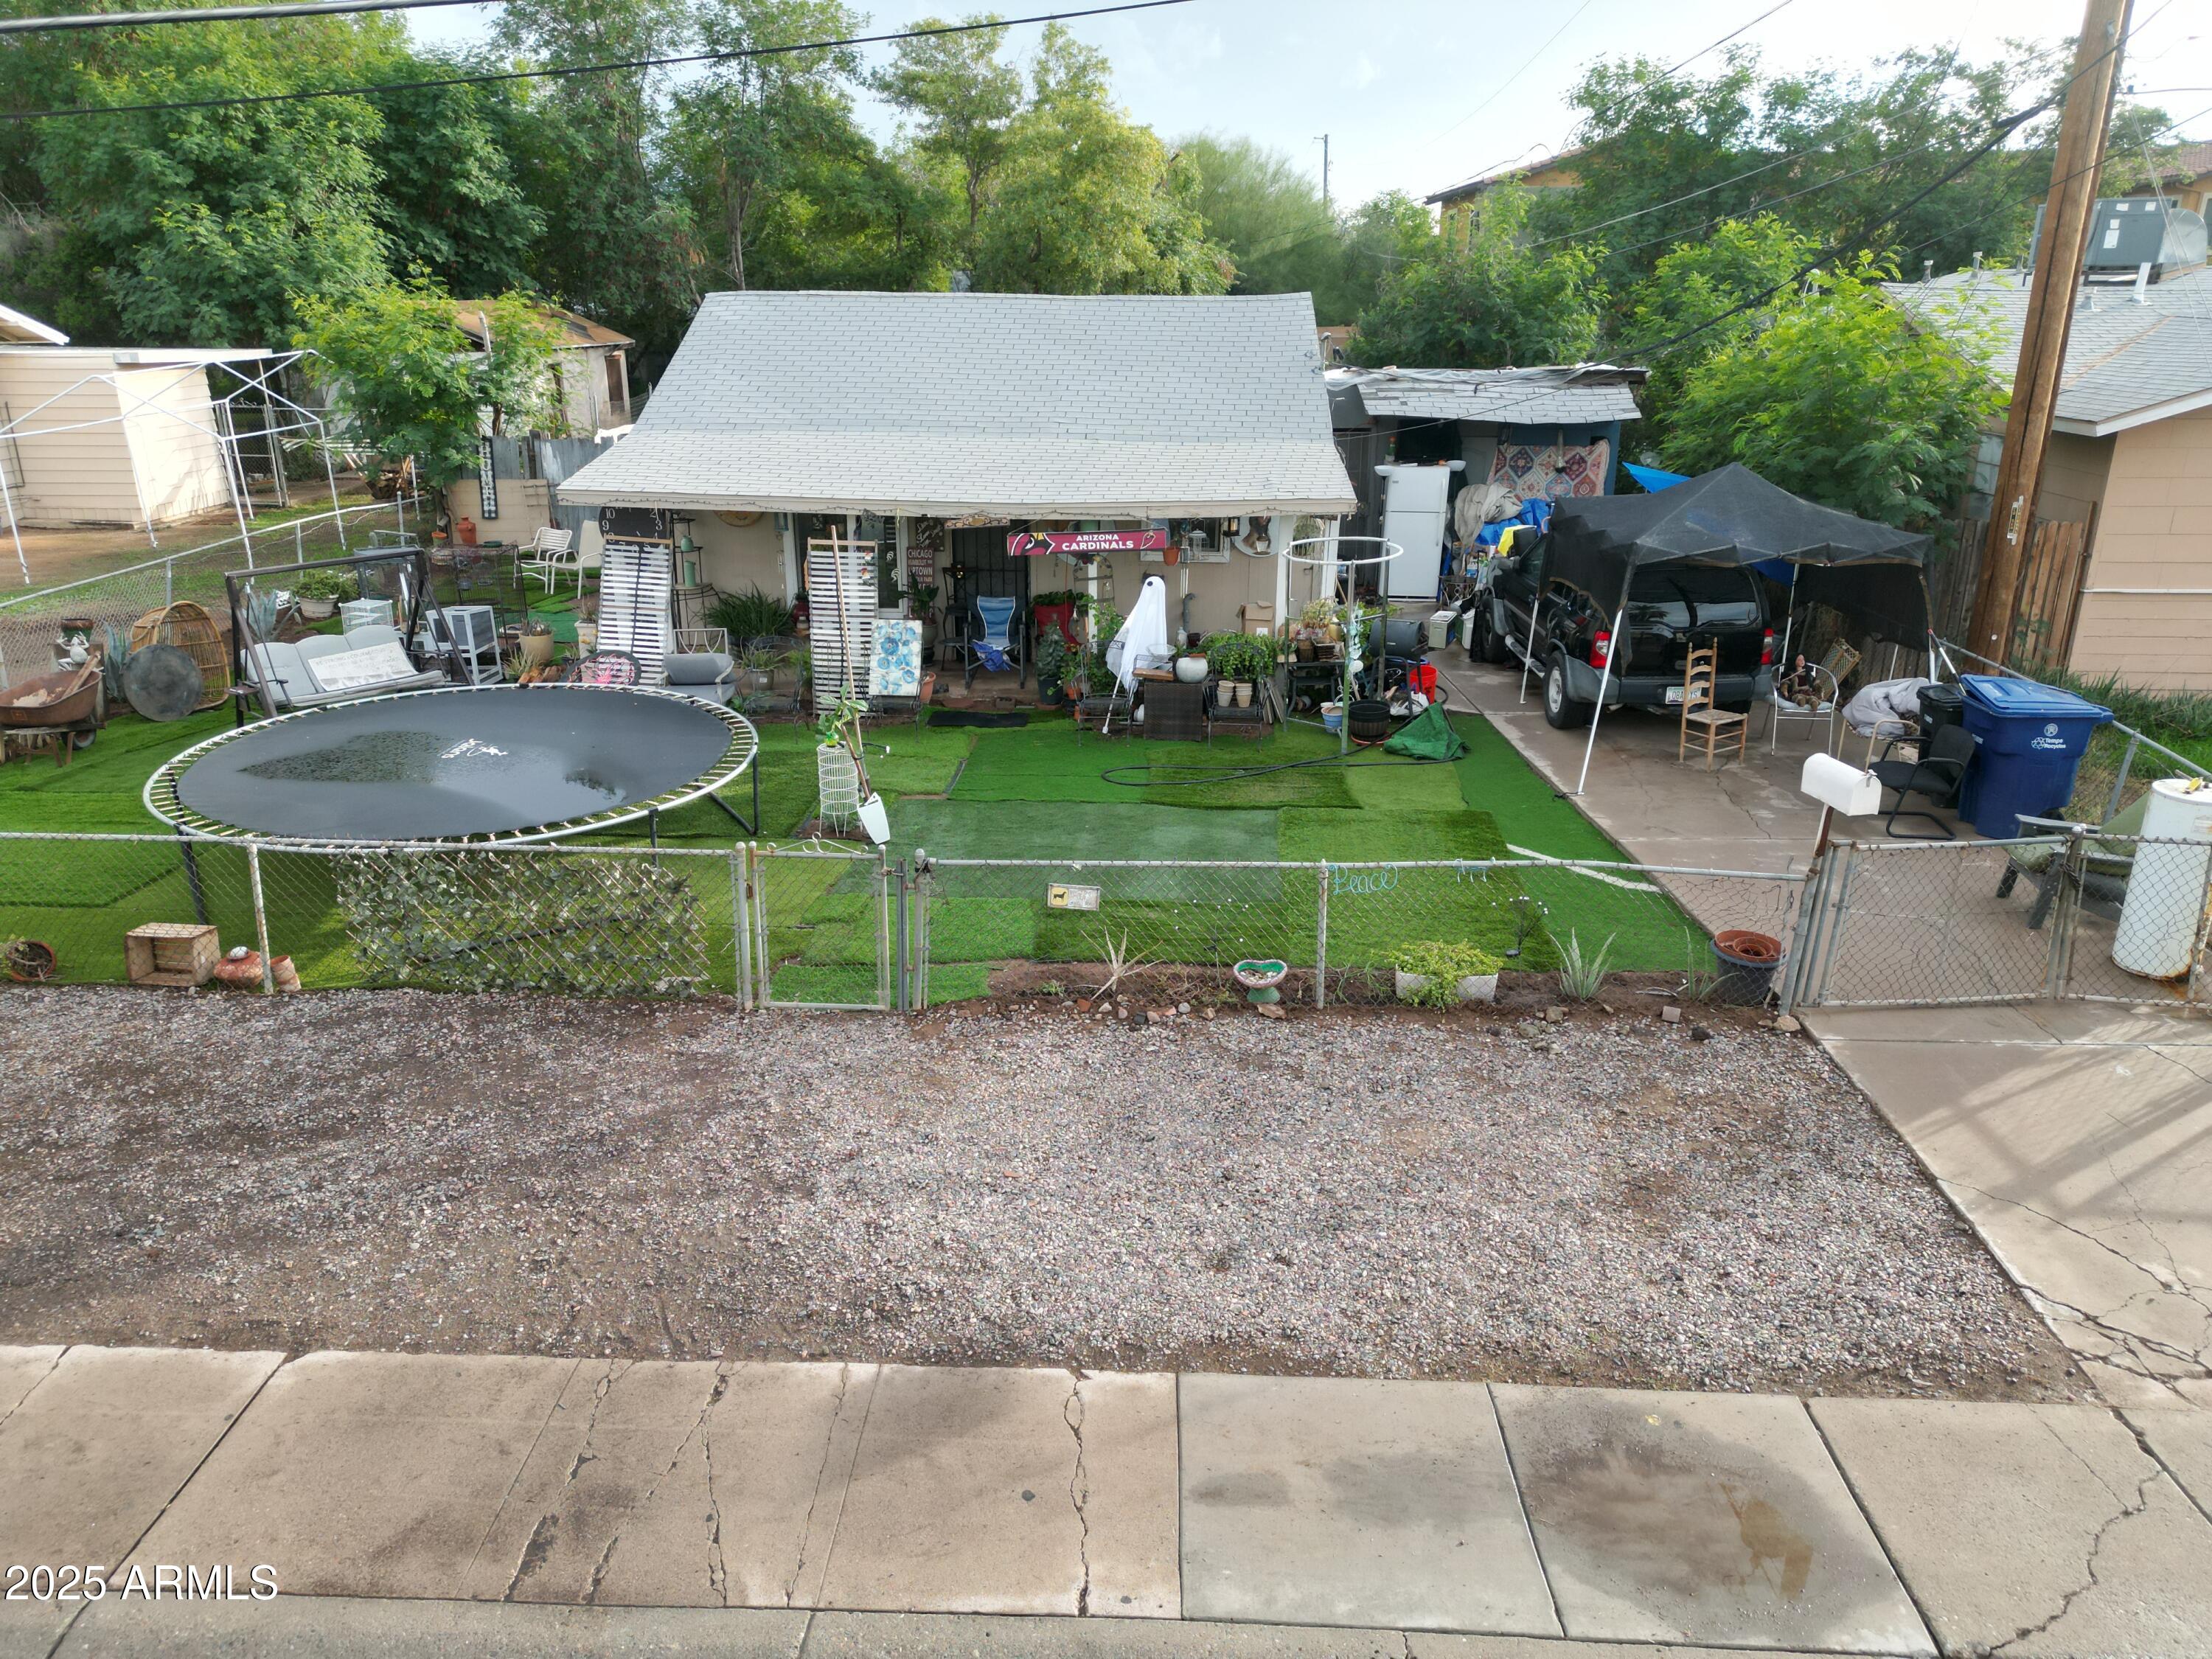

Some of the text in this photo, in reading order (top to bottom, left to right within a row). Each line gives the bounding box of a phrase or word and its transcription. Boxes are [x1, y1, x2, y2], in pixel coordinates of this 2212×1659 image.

[605, 508, 615, 519] 10
[602, 520, 609, 531] 9
[655, 519, 662, 530] 3
[1062, 540, 1134, 551] CARDINALS
[908, 549, 932, 558] CHICAGO
[908, 567, 933, 575] UPTOWN
[1328, 863, 1398, 895] Peace
